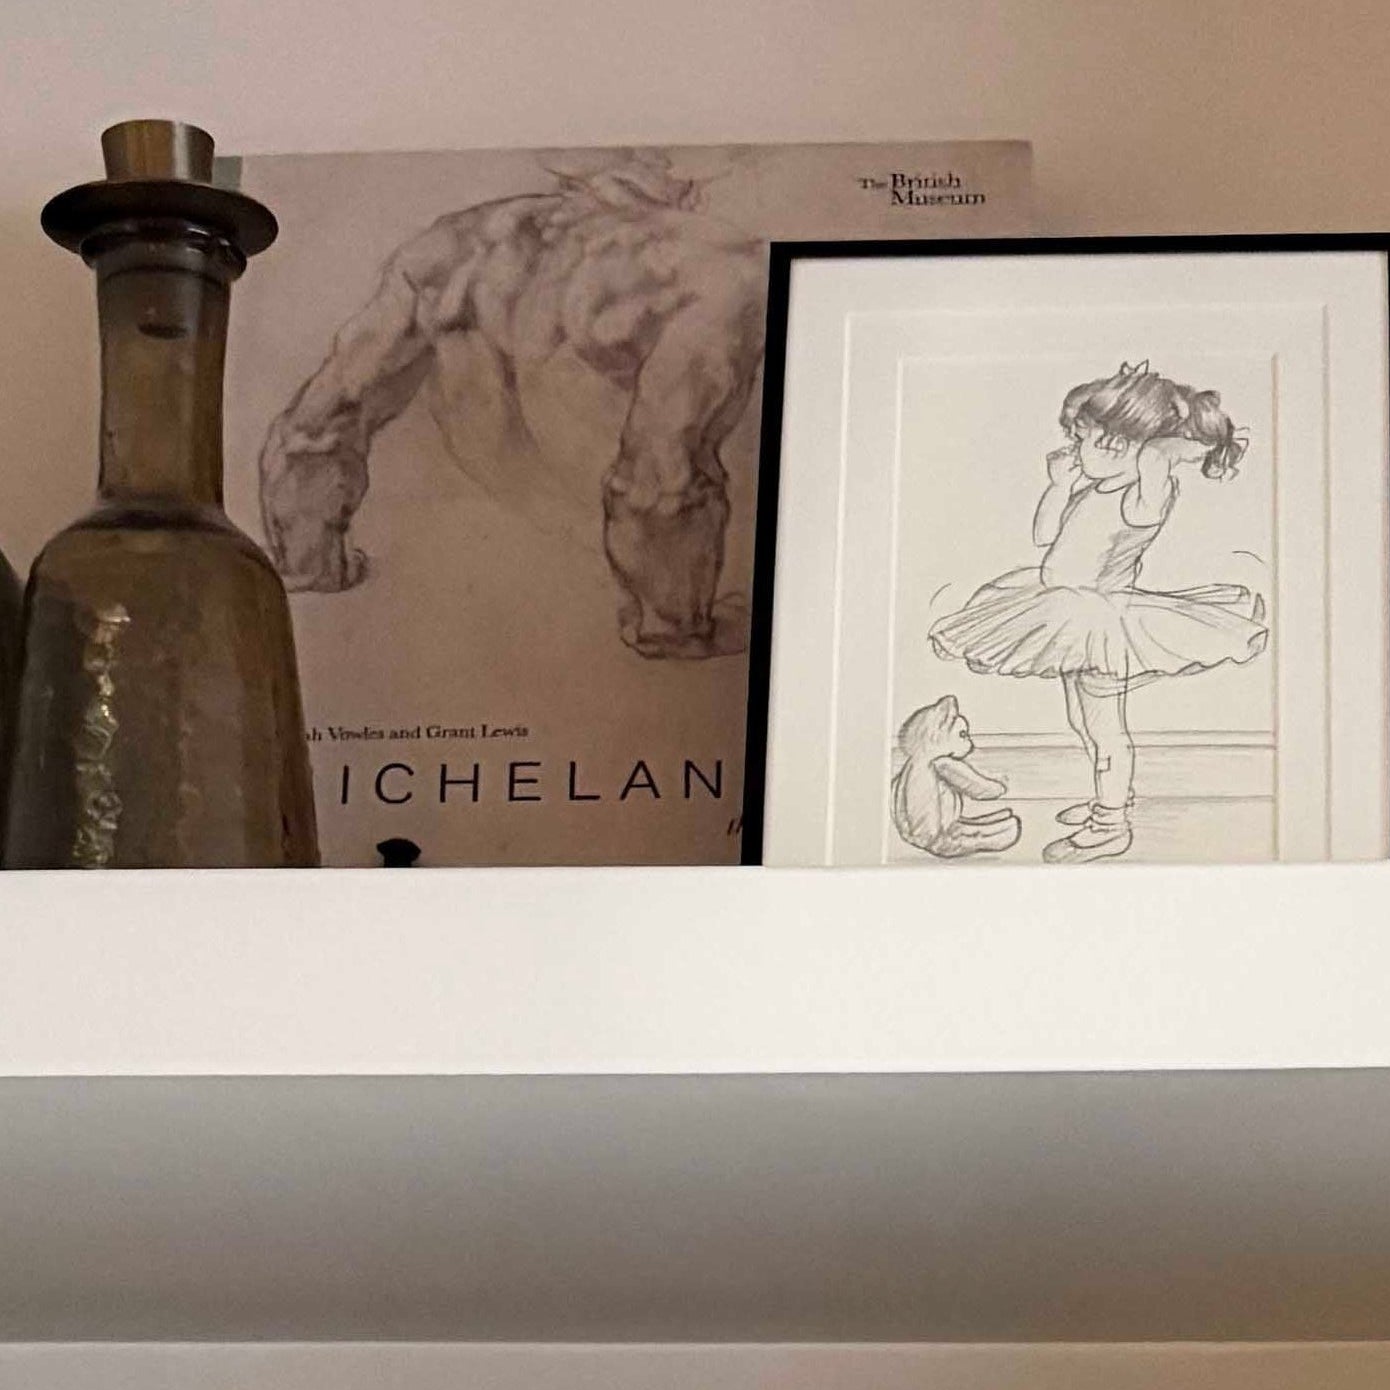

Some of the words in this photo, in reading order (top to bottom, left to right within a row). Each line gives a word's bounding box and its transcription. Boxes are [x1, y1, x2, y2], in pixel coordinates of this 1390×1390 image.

[891, 171, 961, 189] British
[891, 190, 986, 206] Museum
[389, 726, 421, 740] and
[425, 725, 475, 739] Grant
[481, 724, 529, 738] Lewis
[341, 759, 723, 804] ICHELAN
